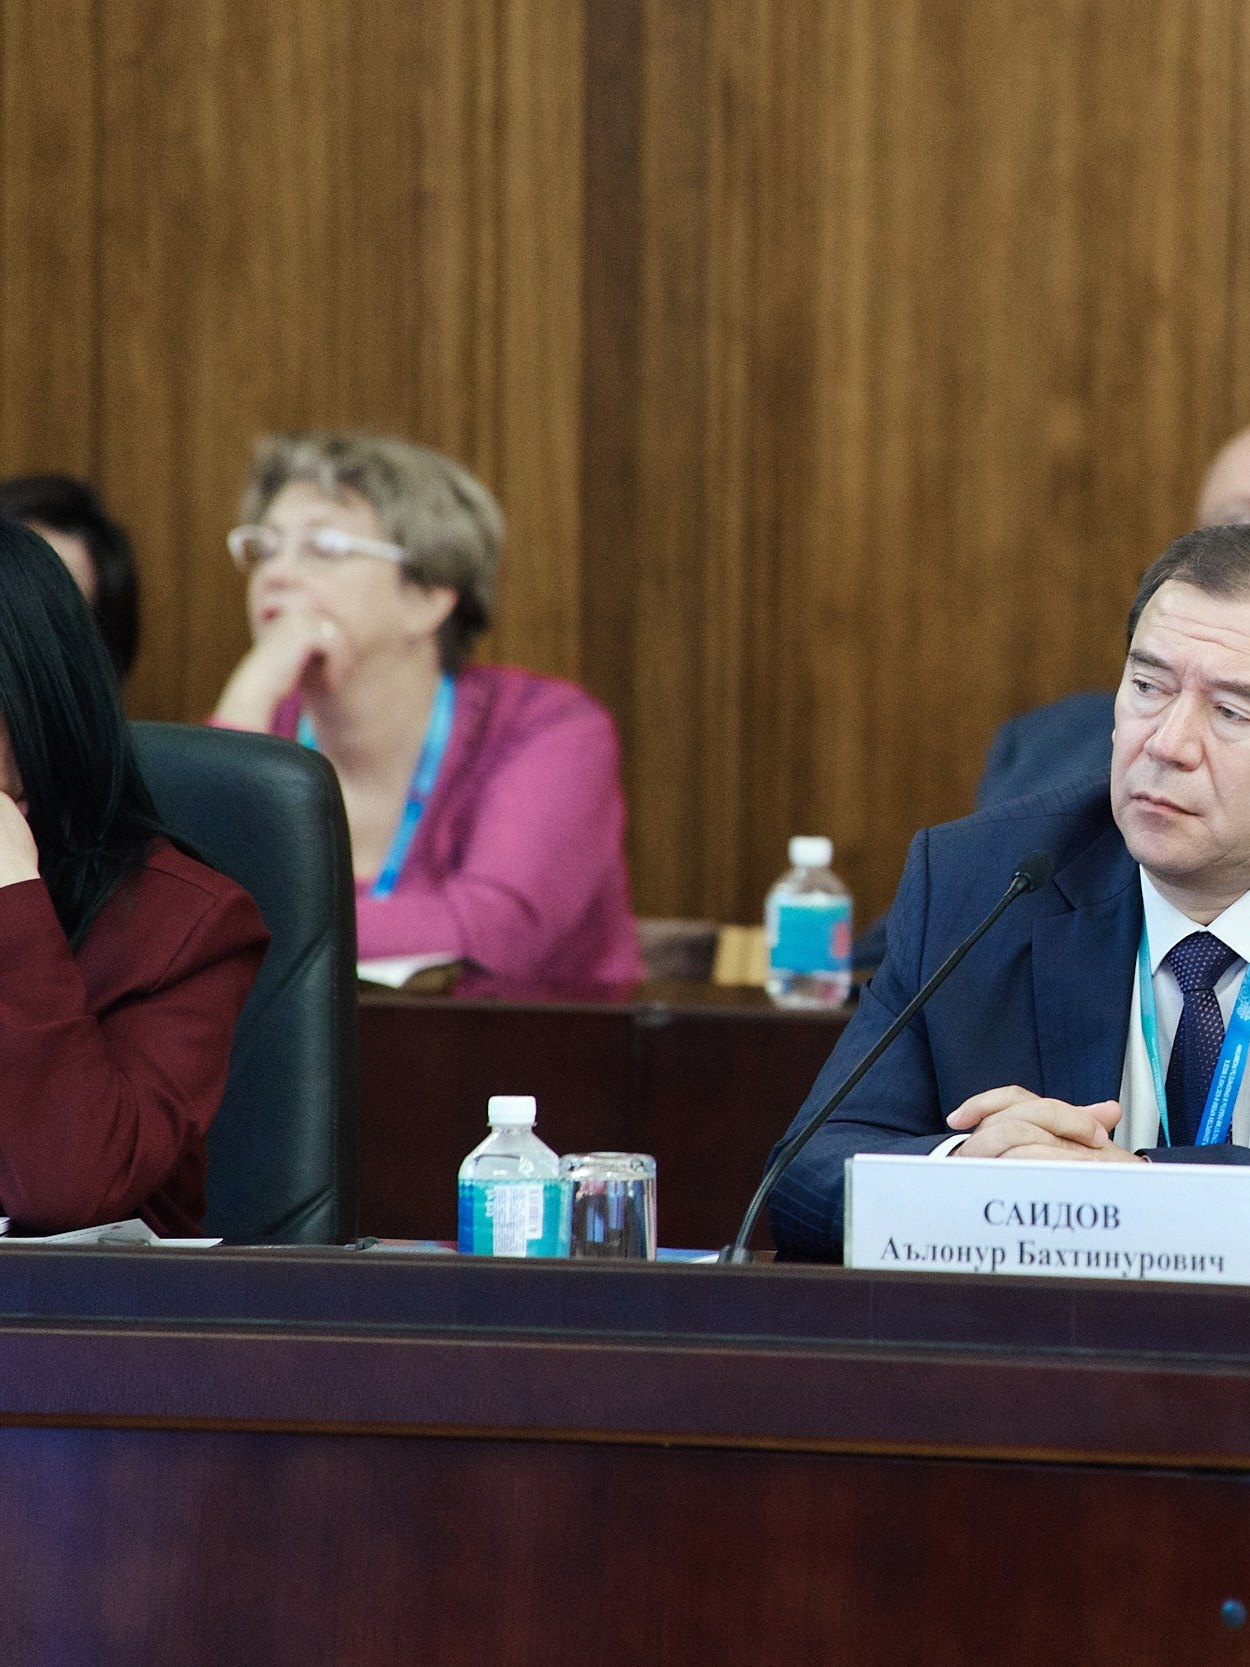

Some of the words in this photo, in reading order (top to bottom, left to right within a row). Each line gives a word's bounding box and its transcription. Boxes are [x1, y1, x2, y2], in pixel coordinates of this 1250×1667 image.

[983, 1200, 1121, 1231] САИДОВ
[880, 1236, 1007, 1273] Аълонур
[1018, 1240, 1226, 1278] Бахтинурович
